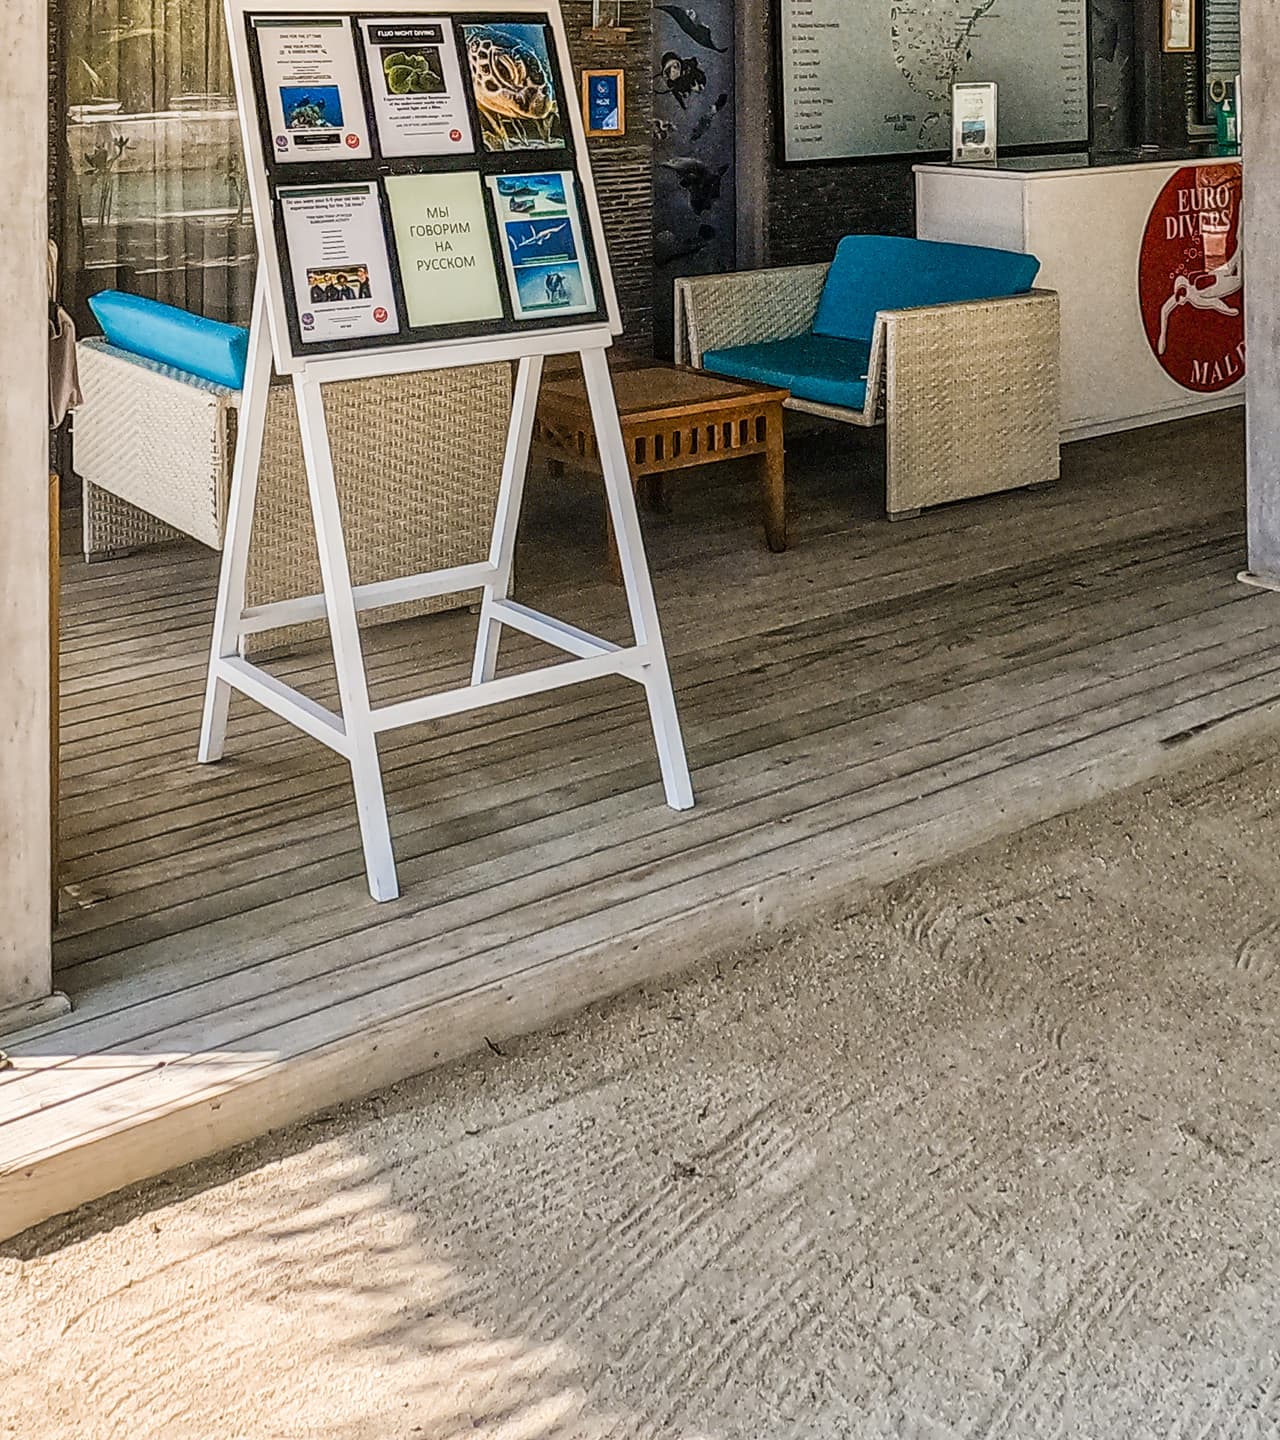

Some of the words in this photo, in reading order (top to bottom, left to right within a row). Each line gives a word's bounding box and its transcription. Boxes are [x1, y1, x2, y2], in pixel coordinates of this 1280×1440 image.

[1177, 185, 1230, 213] EURO
[426, 206, 449, 219] МЫ
[409, 222, 471, 237] ГОВОРИМ
[434, 240, 454, 253] НА
[416, 255, 476, 272] РУССКОМ
